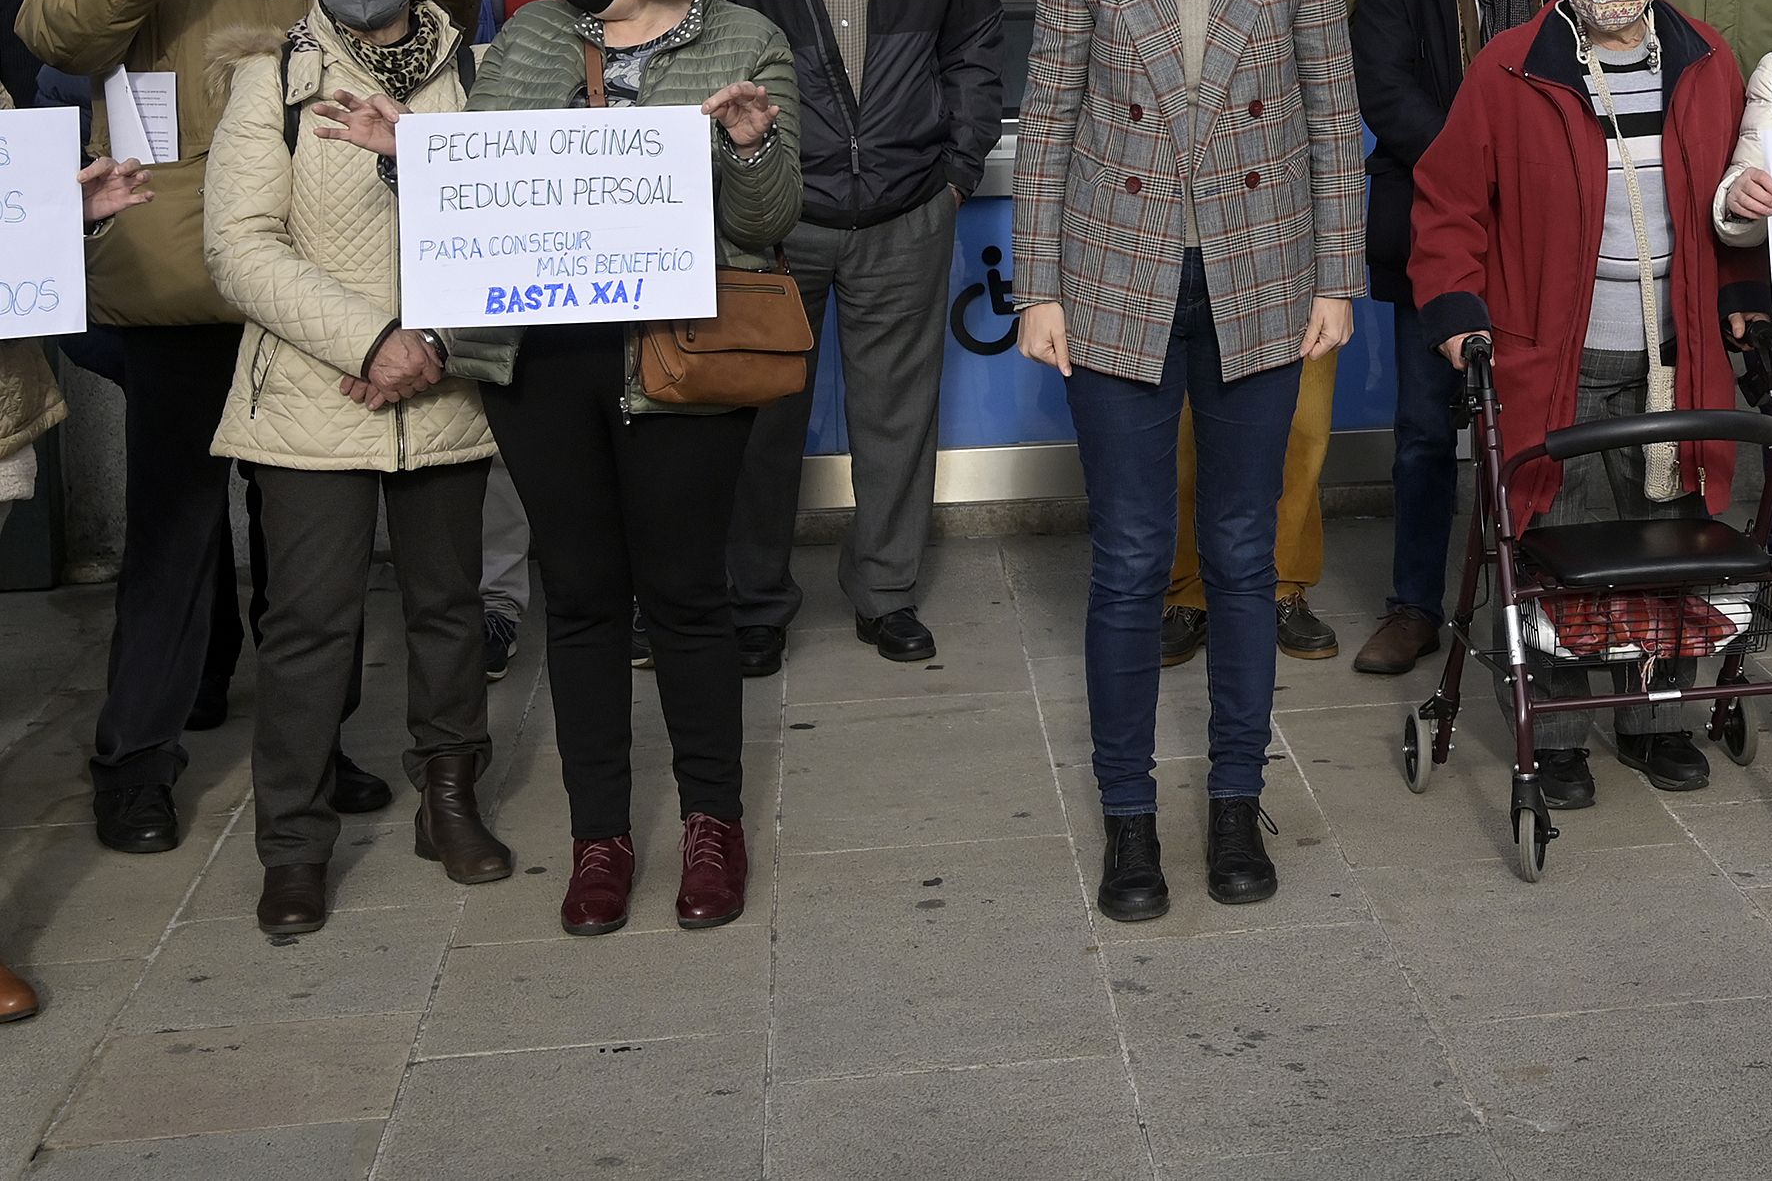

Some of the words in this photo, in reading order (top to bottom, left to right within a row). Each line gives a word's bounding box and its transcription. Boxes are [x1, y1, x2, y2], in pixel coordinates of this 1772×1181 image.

[427, 129, 537, 163] PECHAN
[549, 124, 664, 157] OFICINAS
[440, 178, 563, 212] REDUCEN
[573, 174, 683, 206] PERSOAL
[418, 236, 482, 261] PARA
[488, 230, 592, 256] CONSEGUIR
[536, 251, 588, 277] MÁIS
[594, 247, 694, 275] BENEFICIO
[484, 282, 580, 315] BASTA
[588, 278, 644, 310] XA!
